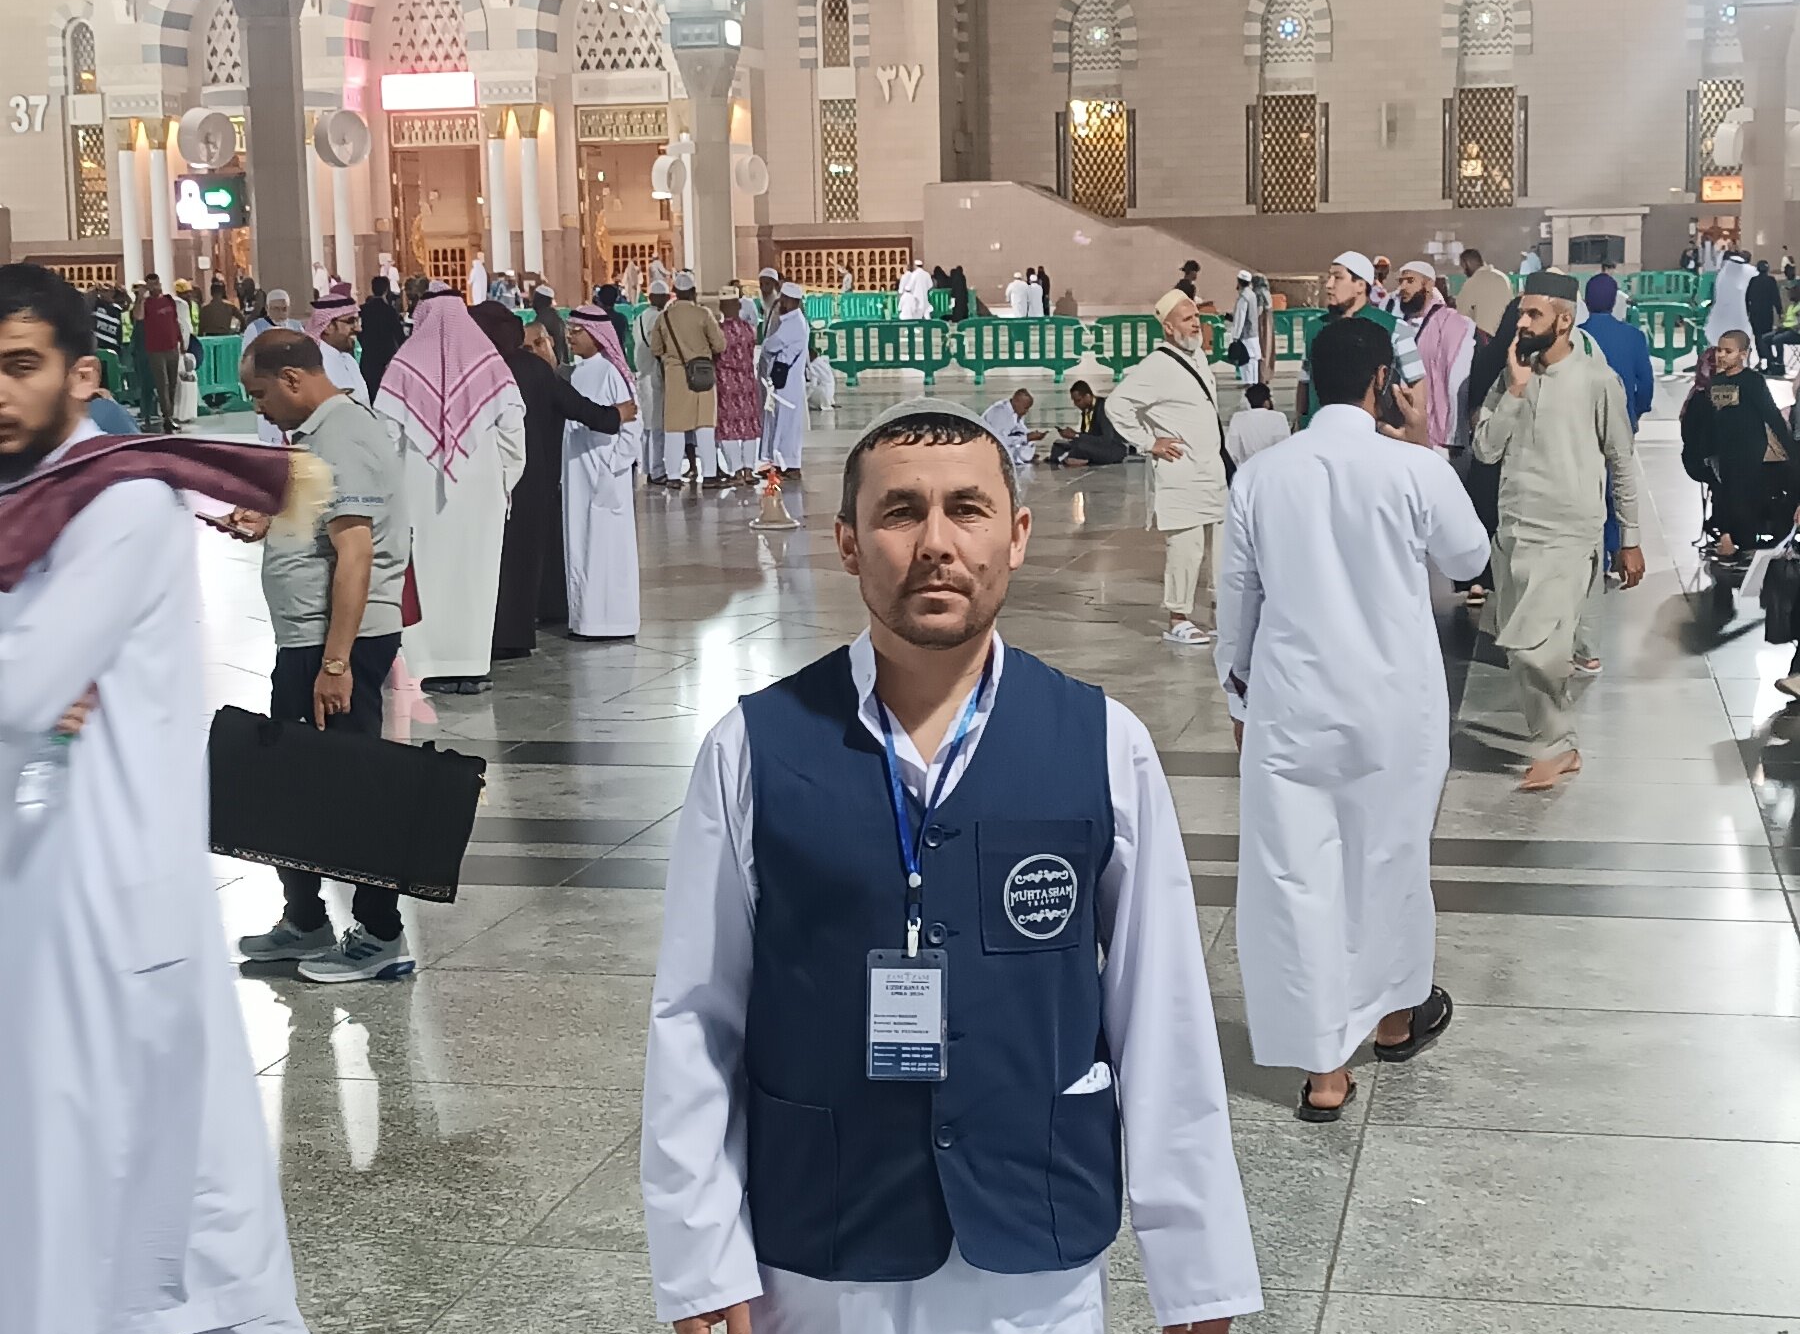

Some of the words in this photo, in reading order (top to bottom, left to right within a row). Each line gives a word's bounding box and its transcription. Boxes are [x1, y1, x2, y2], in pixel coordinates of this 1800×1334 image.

[876, 64, 922, 103] ٣٧
[9, 95, 48, 133] 37
[1010, 884, 1073, 907] MUHTASHAM
